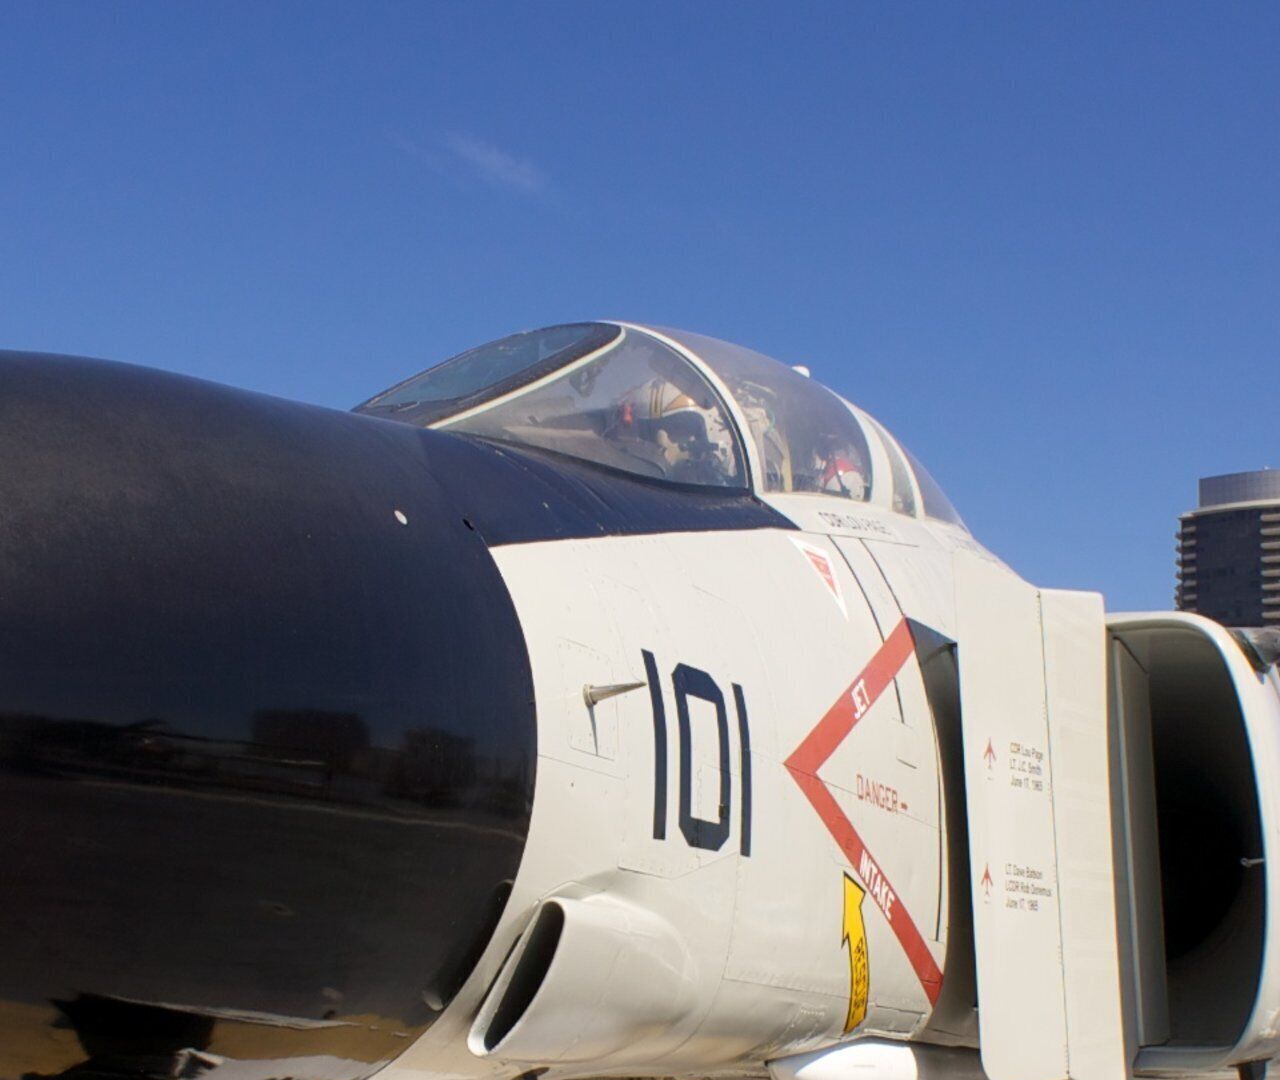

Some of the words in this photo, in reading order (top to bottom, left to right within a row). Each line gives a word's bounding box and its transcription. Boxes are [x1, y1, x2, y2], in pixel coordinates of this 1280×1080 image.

[851, 678, 871, 719] JET
[640, 647, 752, 857] 101
[856, 773, 899, 815] DANGER
[859, 849, 896, 920] INTAKE
